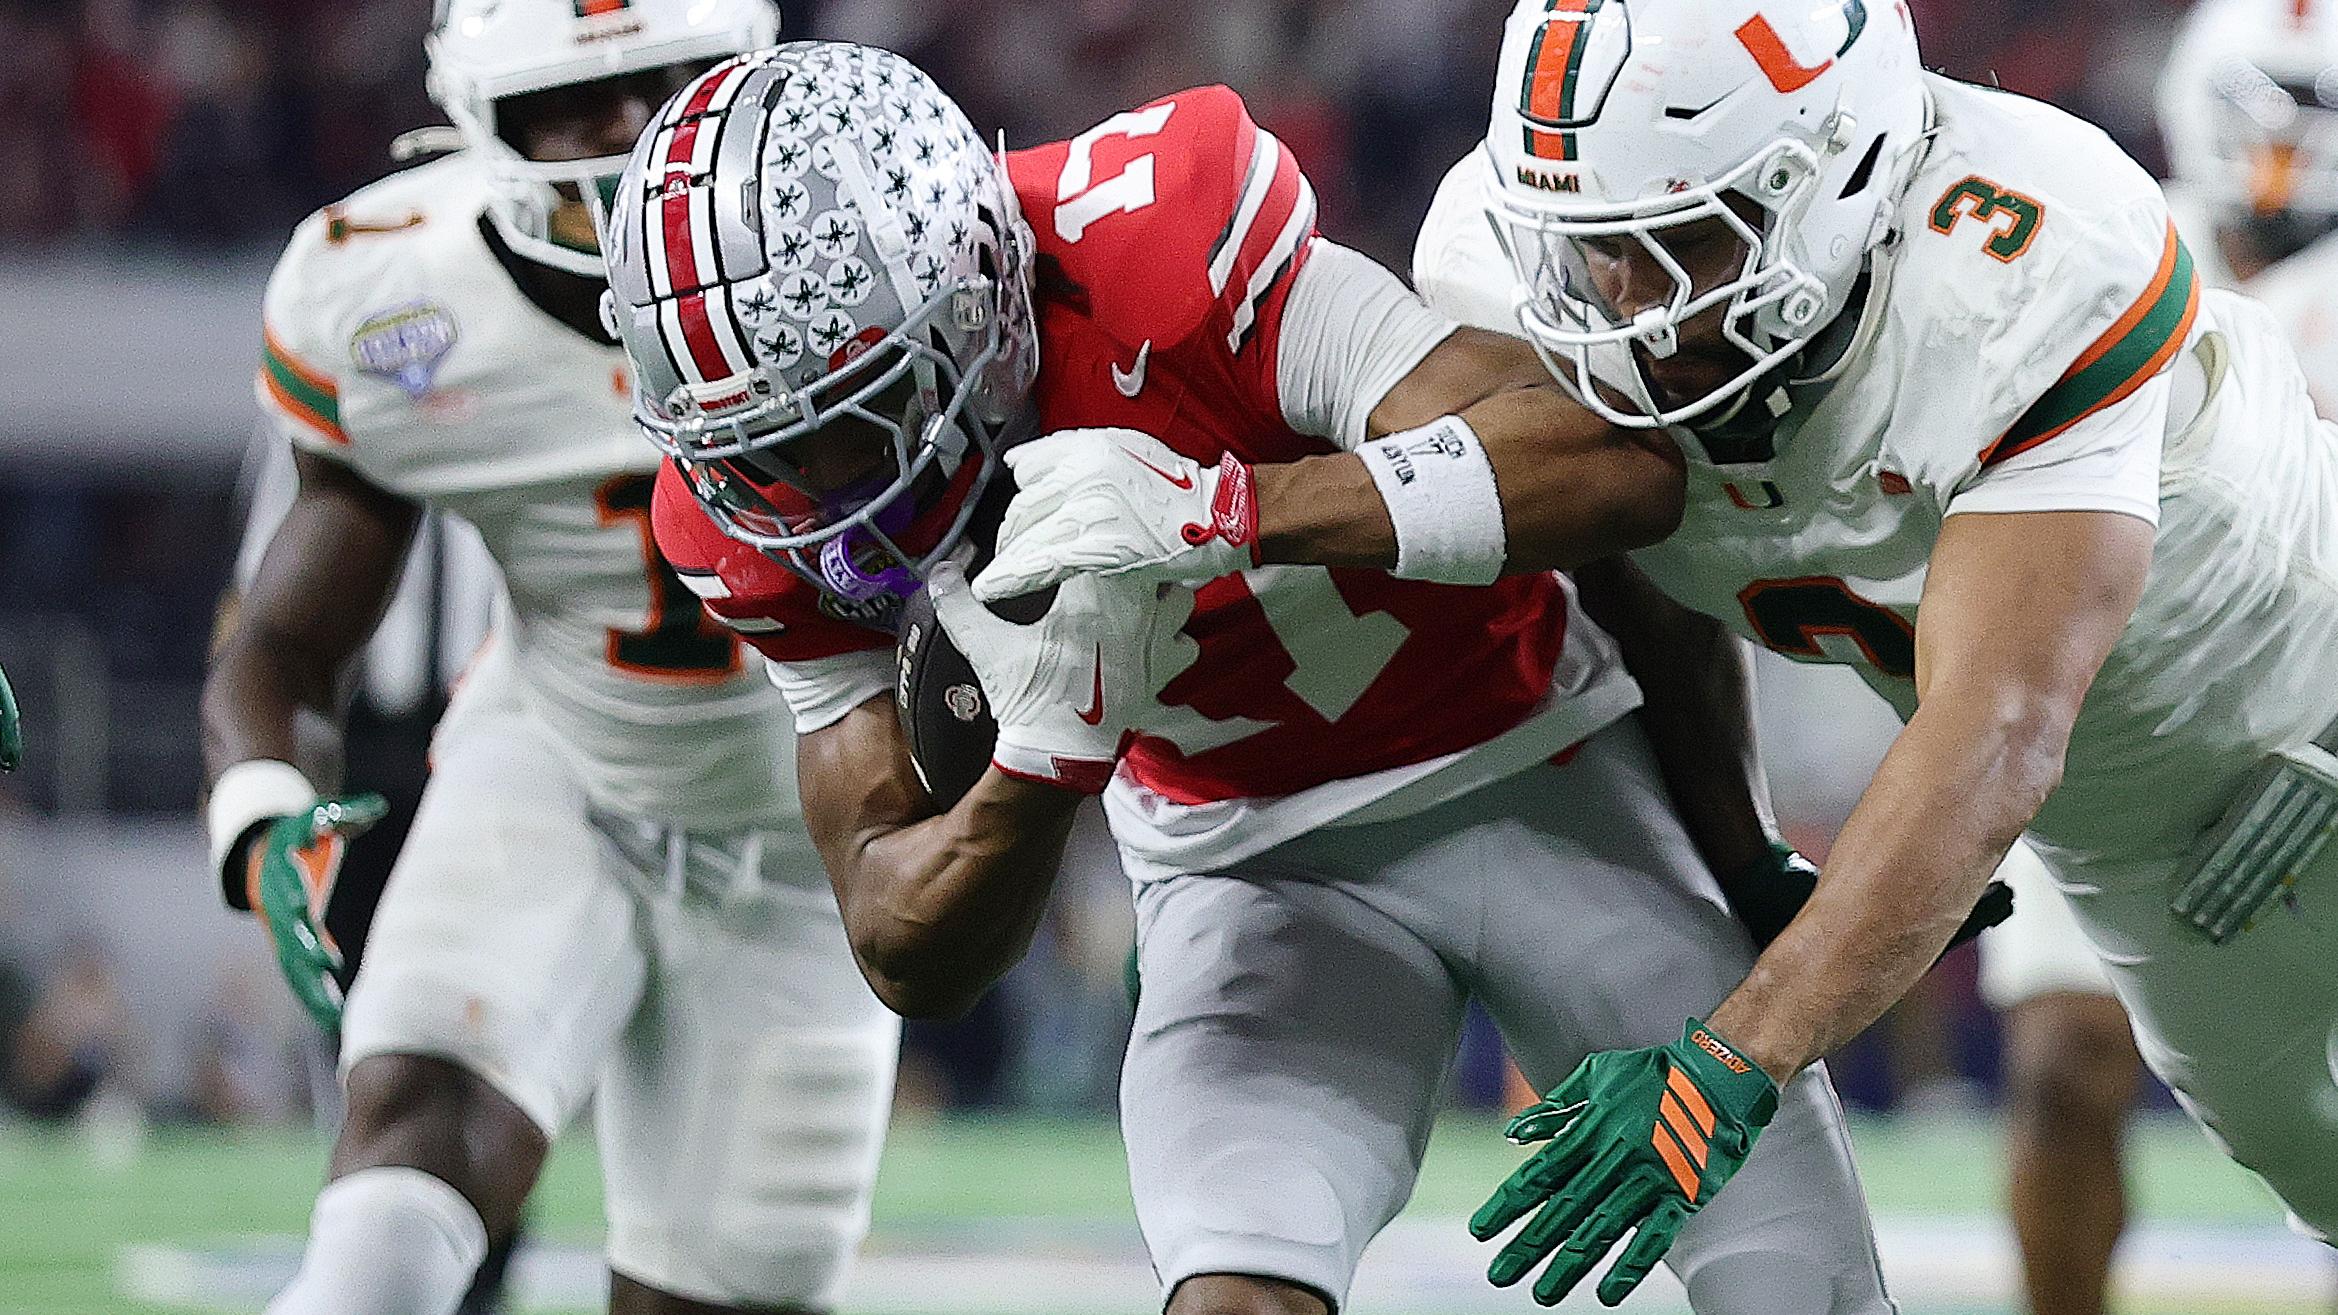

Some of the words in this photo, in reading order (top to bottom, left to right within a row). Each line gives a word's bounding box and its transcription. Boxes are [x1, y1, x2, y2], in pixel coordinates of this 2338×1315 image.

[1734, 0, 1867, 93] U
[1054, 100, 1177, 245] 17
[1516, 163, 1581, 194] MIAMI
[1928, 174, 2046, 264] 3
[1723, 480, 1785, 512] U
[1690, 1029, 1753, 1075] ADIZERO
